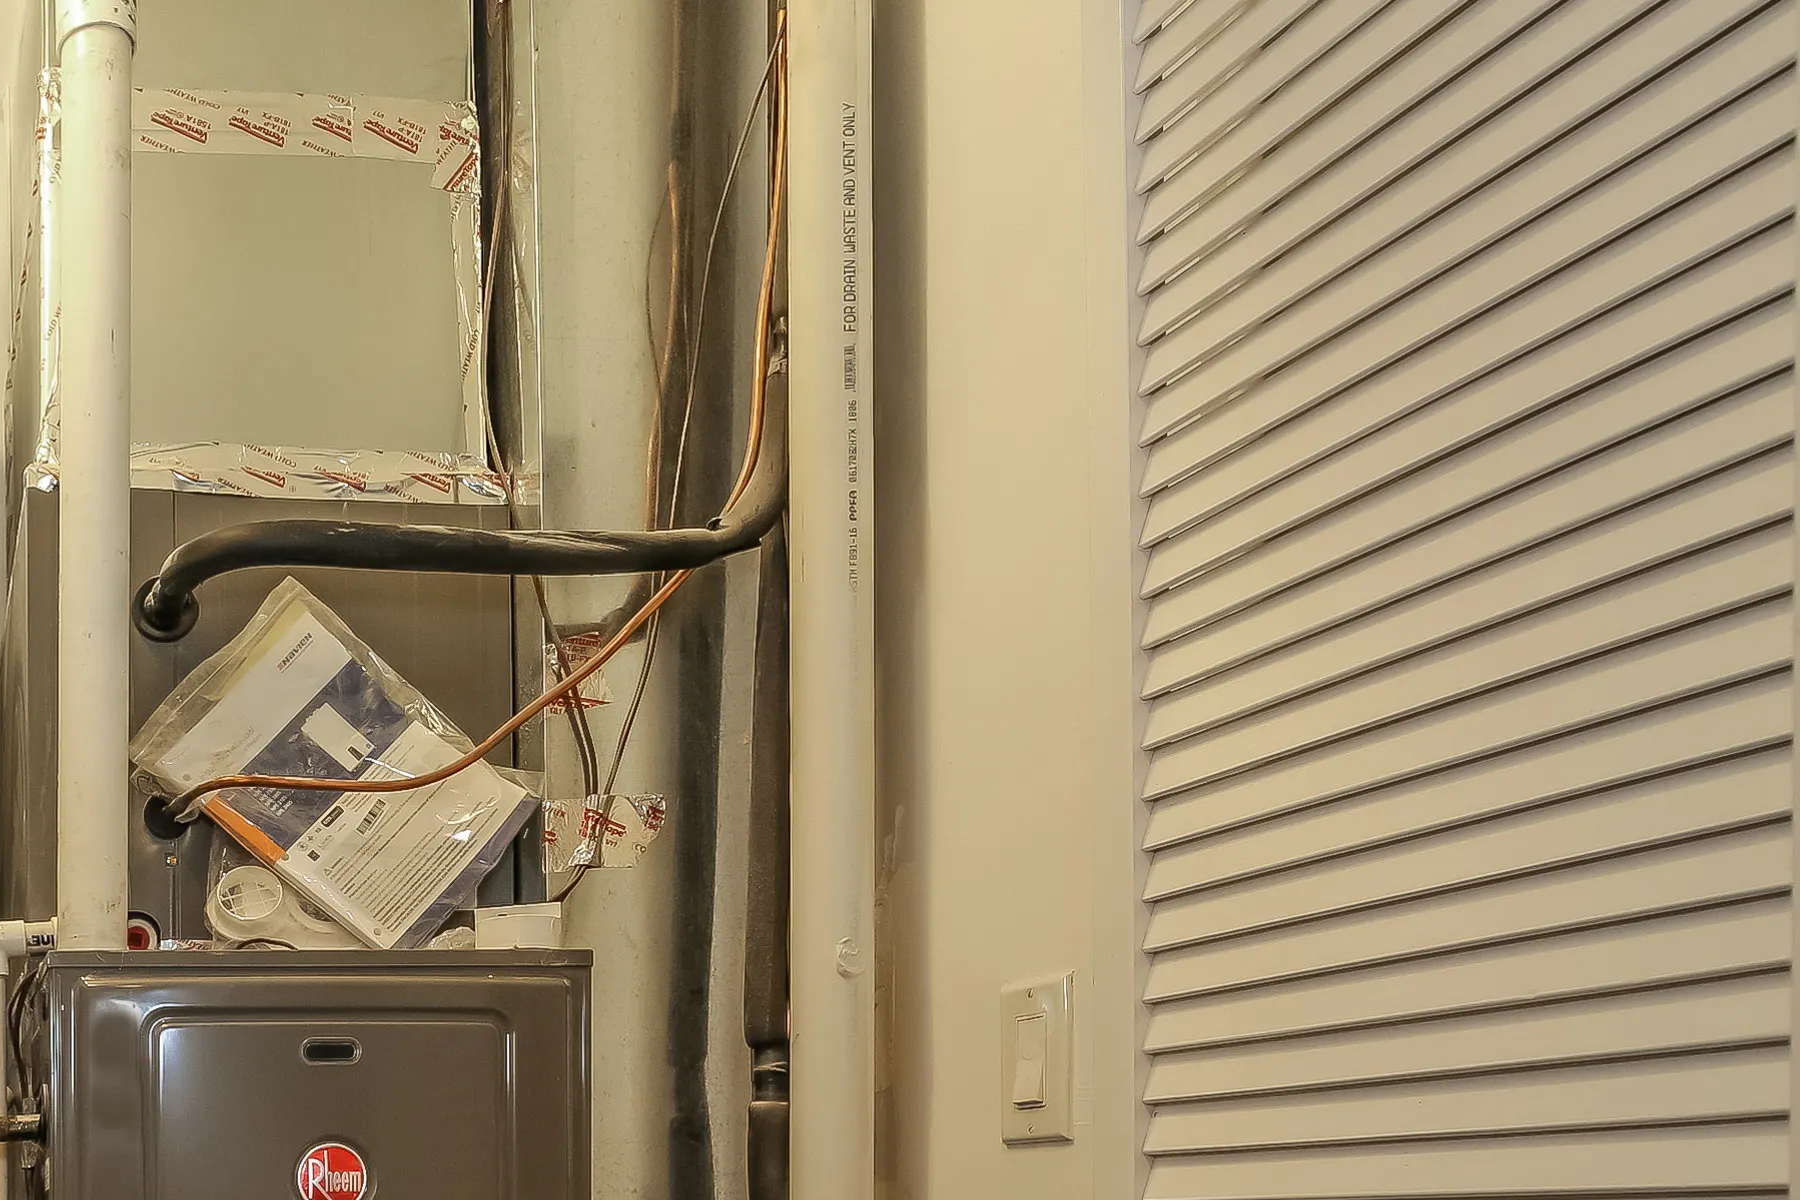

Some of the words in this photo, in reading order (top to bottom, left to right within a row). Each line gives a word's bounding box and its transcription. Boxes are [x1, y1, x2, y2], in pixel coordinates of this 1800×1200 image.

[842, 103, 856, 137] ONLY
[842, 141, 856, 176] VENT
[842, 179, 856, 206] AND
[842, 209, 857, 254] WASTE
[843, 306, 857, 333] FOR
[308, 1150, 361, 1200] Rheem
